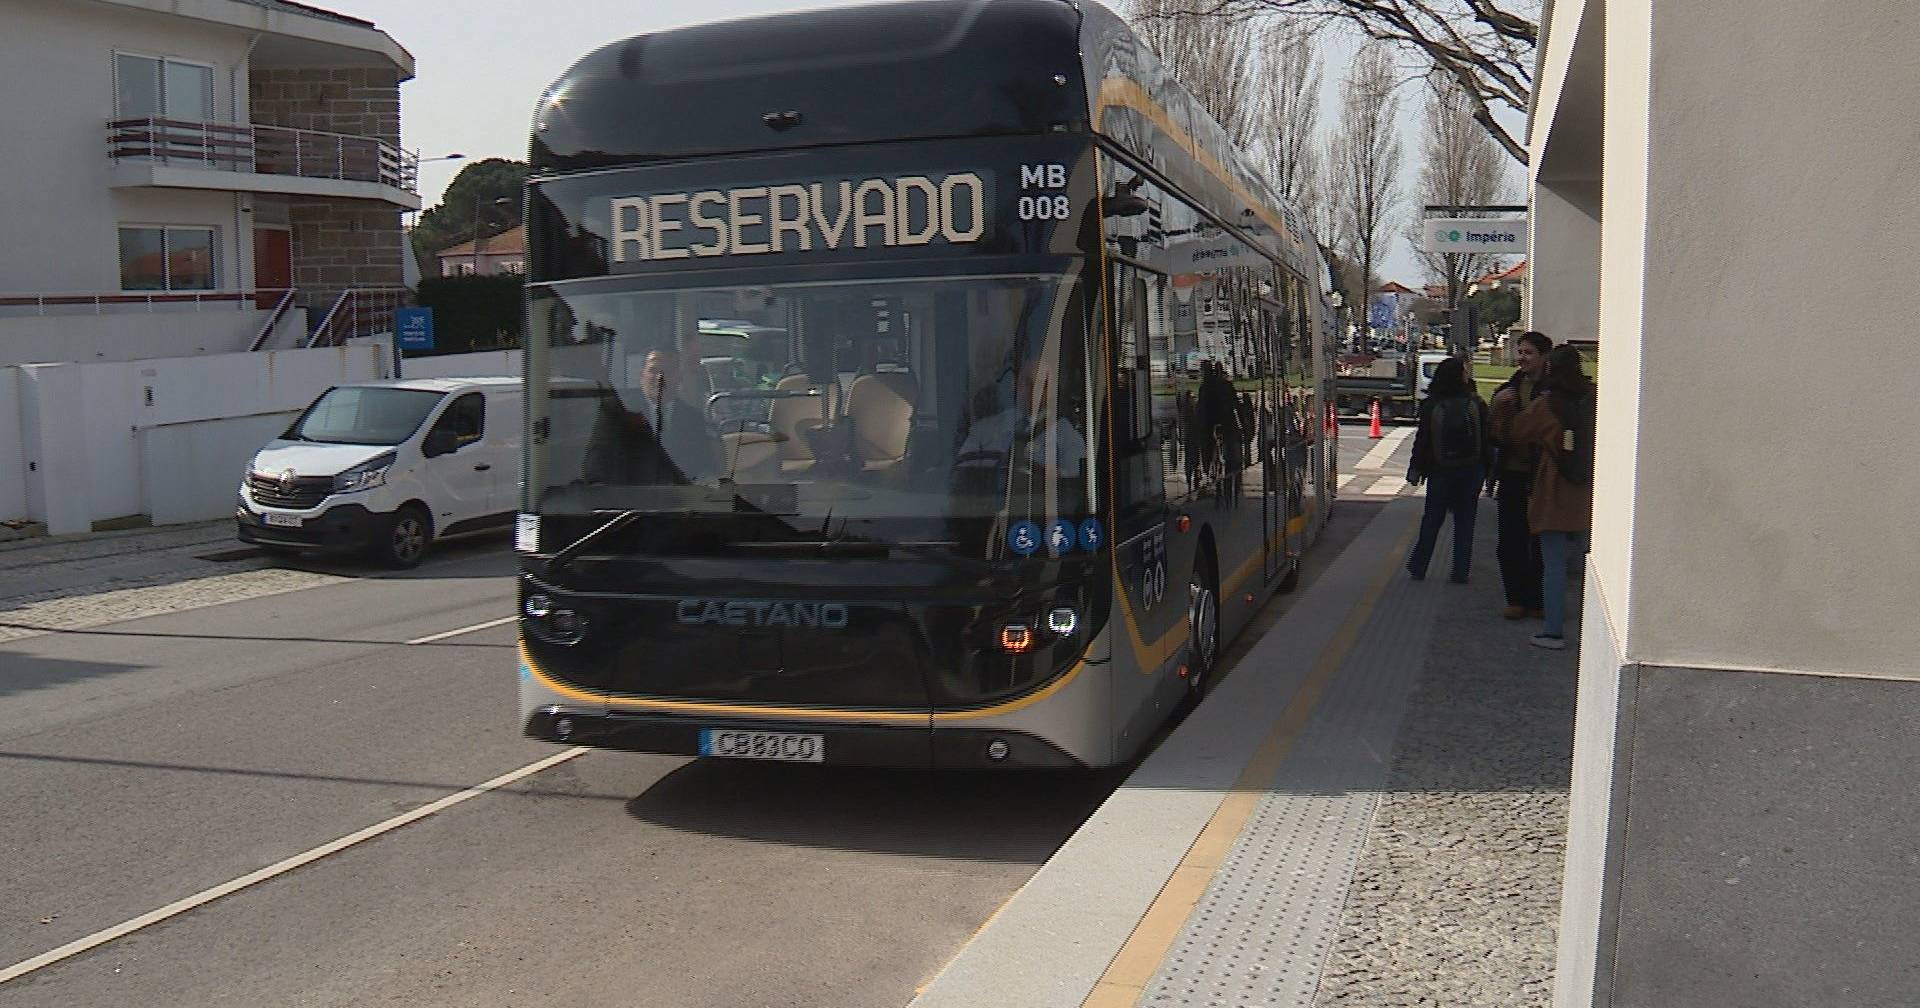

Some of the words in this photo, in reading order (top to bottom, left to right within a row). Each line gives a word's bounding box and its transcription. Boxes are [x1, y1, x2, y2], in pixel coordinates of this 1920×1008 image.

[1020, 164, 1066, 189] MB
[610, 172, 984, 262] RESERVADO
[1019, 195, 1070, 220] 008
[1466, 229, 1516, 244] Império
[676, 599, 848, 628] CAETANO
